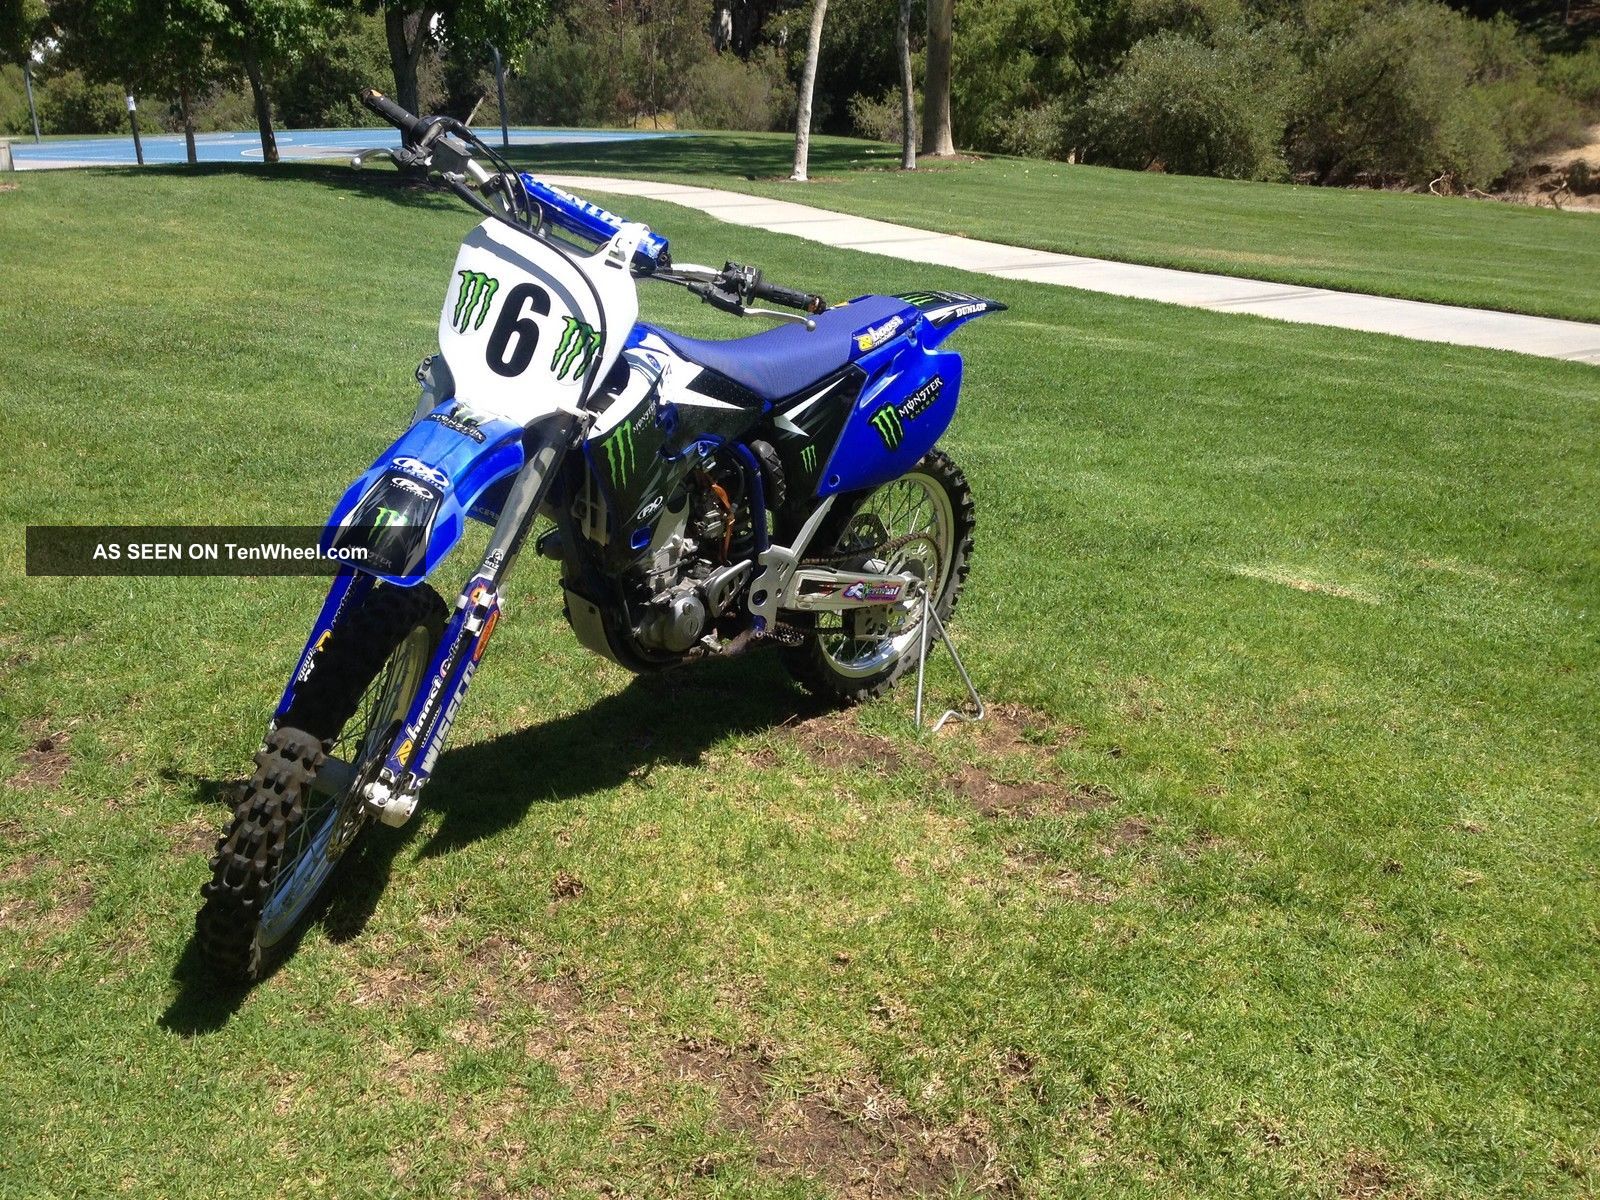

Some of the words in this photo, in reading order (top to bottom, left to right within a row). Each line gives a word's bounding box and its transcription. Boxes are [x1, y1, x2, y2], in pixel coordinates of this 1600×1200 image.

[956, 302, 988, 318] DUNLOP
[486, 282, 551, 378] 6
[867, 315, 904, 340] boost
